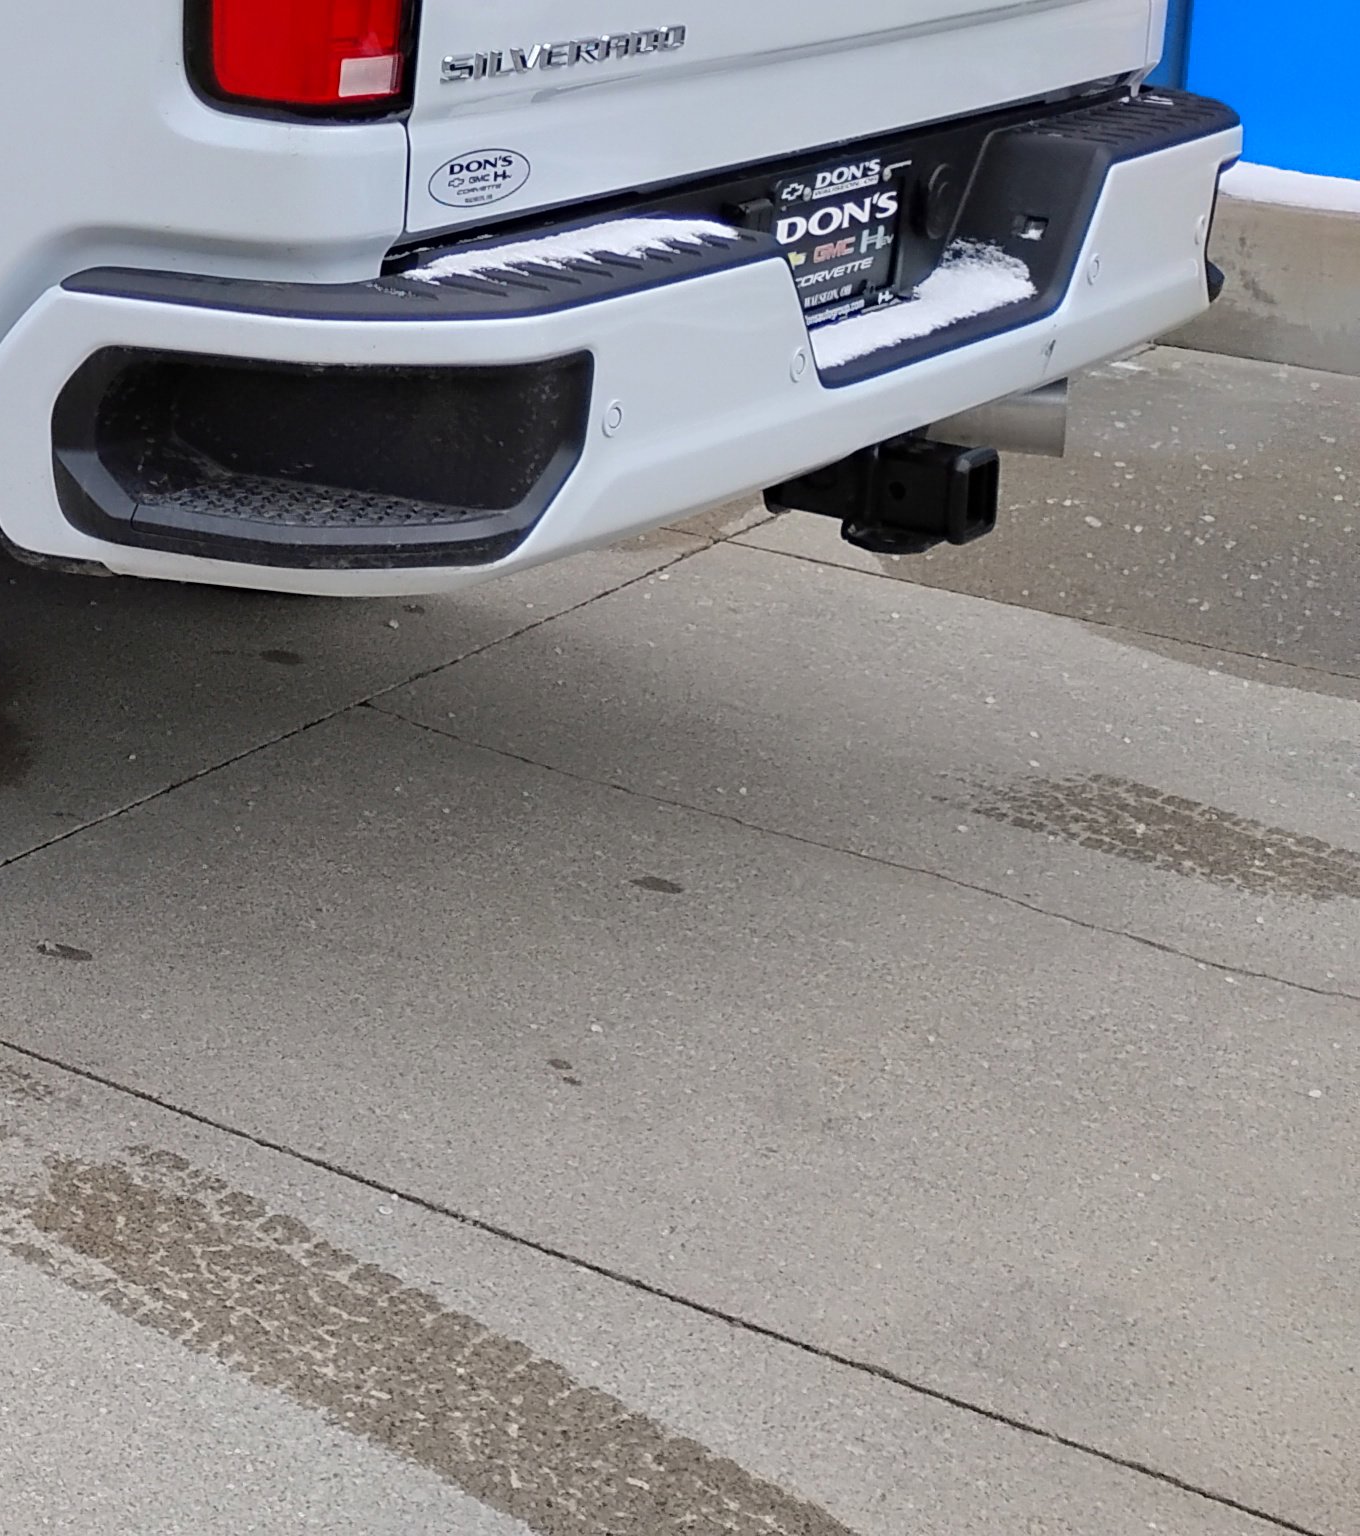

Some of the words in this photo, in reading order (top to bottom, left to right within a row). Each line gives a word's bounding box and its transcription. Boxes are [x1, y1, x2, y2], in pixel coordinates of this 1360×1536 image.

[440, 25, 687, 84] SILVERADO
[449, 155, 513, 175] DON'S
[468, 173, 490, 184] GMC
[814, 159, 880, 189] DON'S
[776, 191, 898, 245] DON'S
[813, 236, 856, 263] GMC
